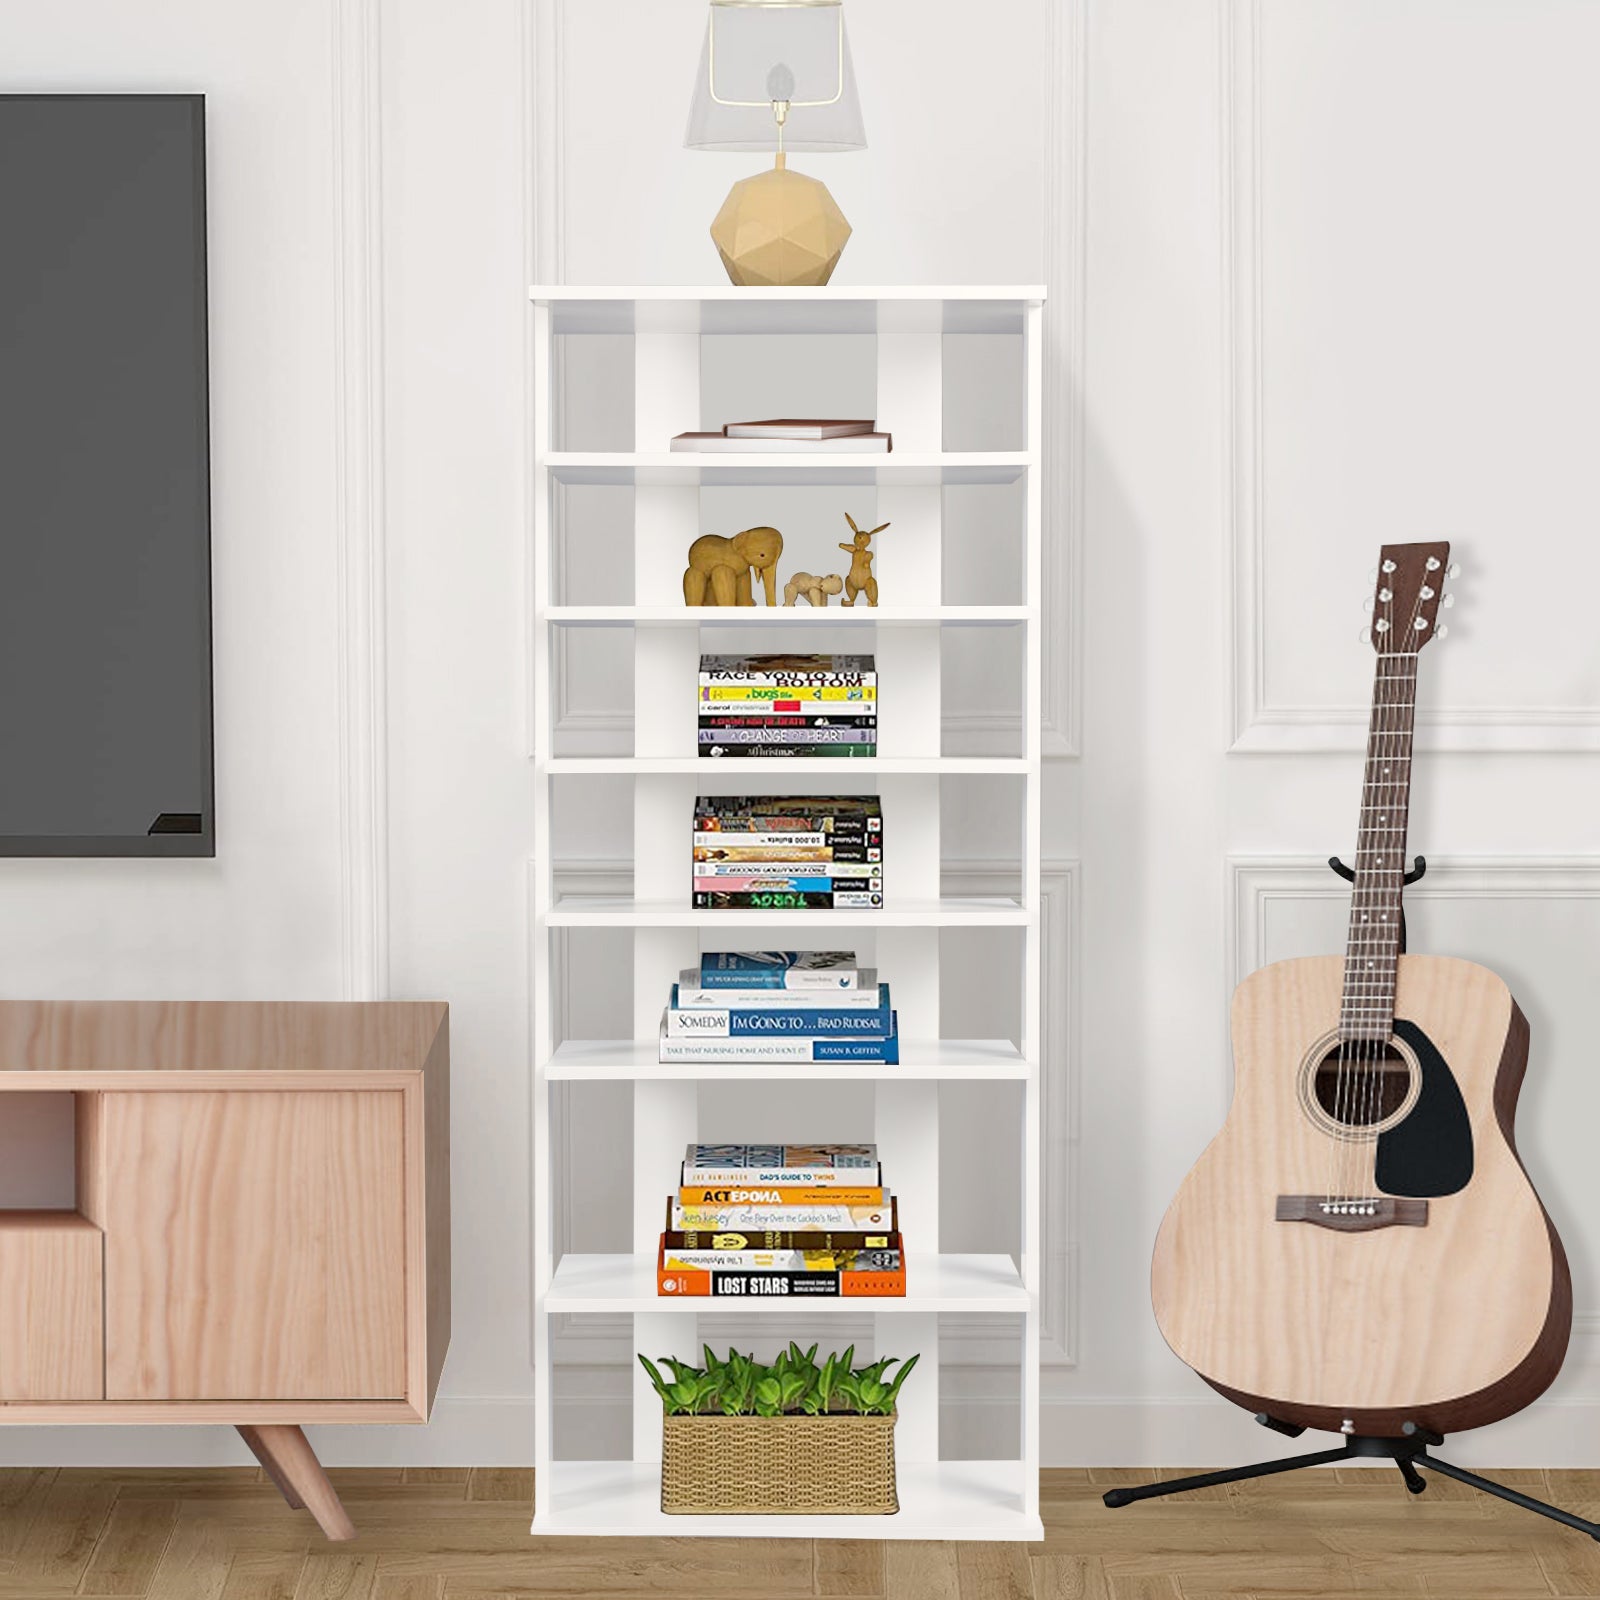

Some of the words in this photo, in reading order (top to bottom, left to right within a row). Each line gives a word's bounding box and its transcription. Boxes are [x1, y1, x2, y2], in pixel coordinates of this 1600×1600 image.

[709, 672, 756, 680] RACE
[763, 672, 798, 680] YOU
[776, 679, 863, 687] BOTTOM
[740, 730, 788, 743] CHANGE
[808, 730, 845, 743] HEART
[678, 1014, 728, 1028] SOMEDAY
[749, 1015, 787, 1029] GOING
[818, 1017, 842, 1029] BRAD
[820, 1047, 844, 1055] SUSAN
[718, 1277, 748, 1294] LOST
[750, 1277, 789, 1294] STARS
